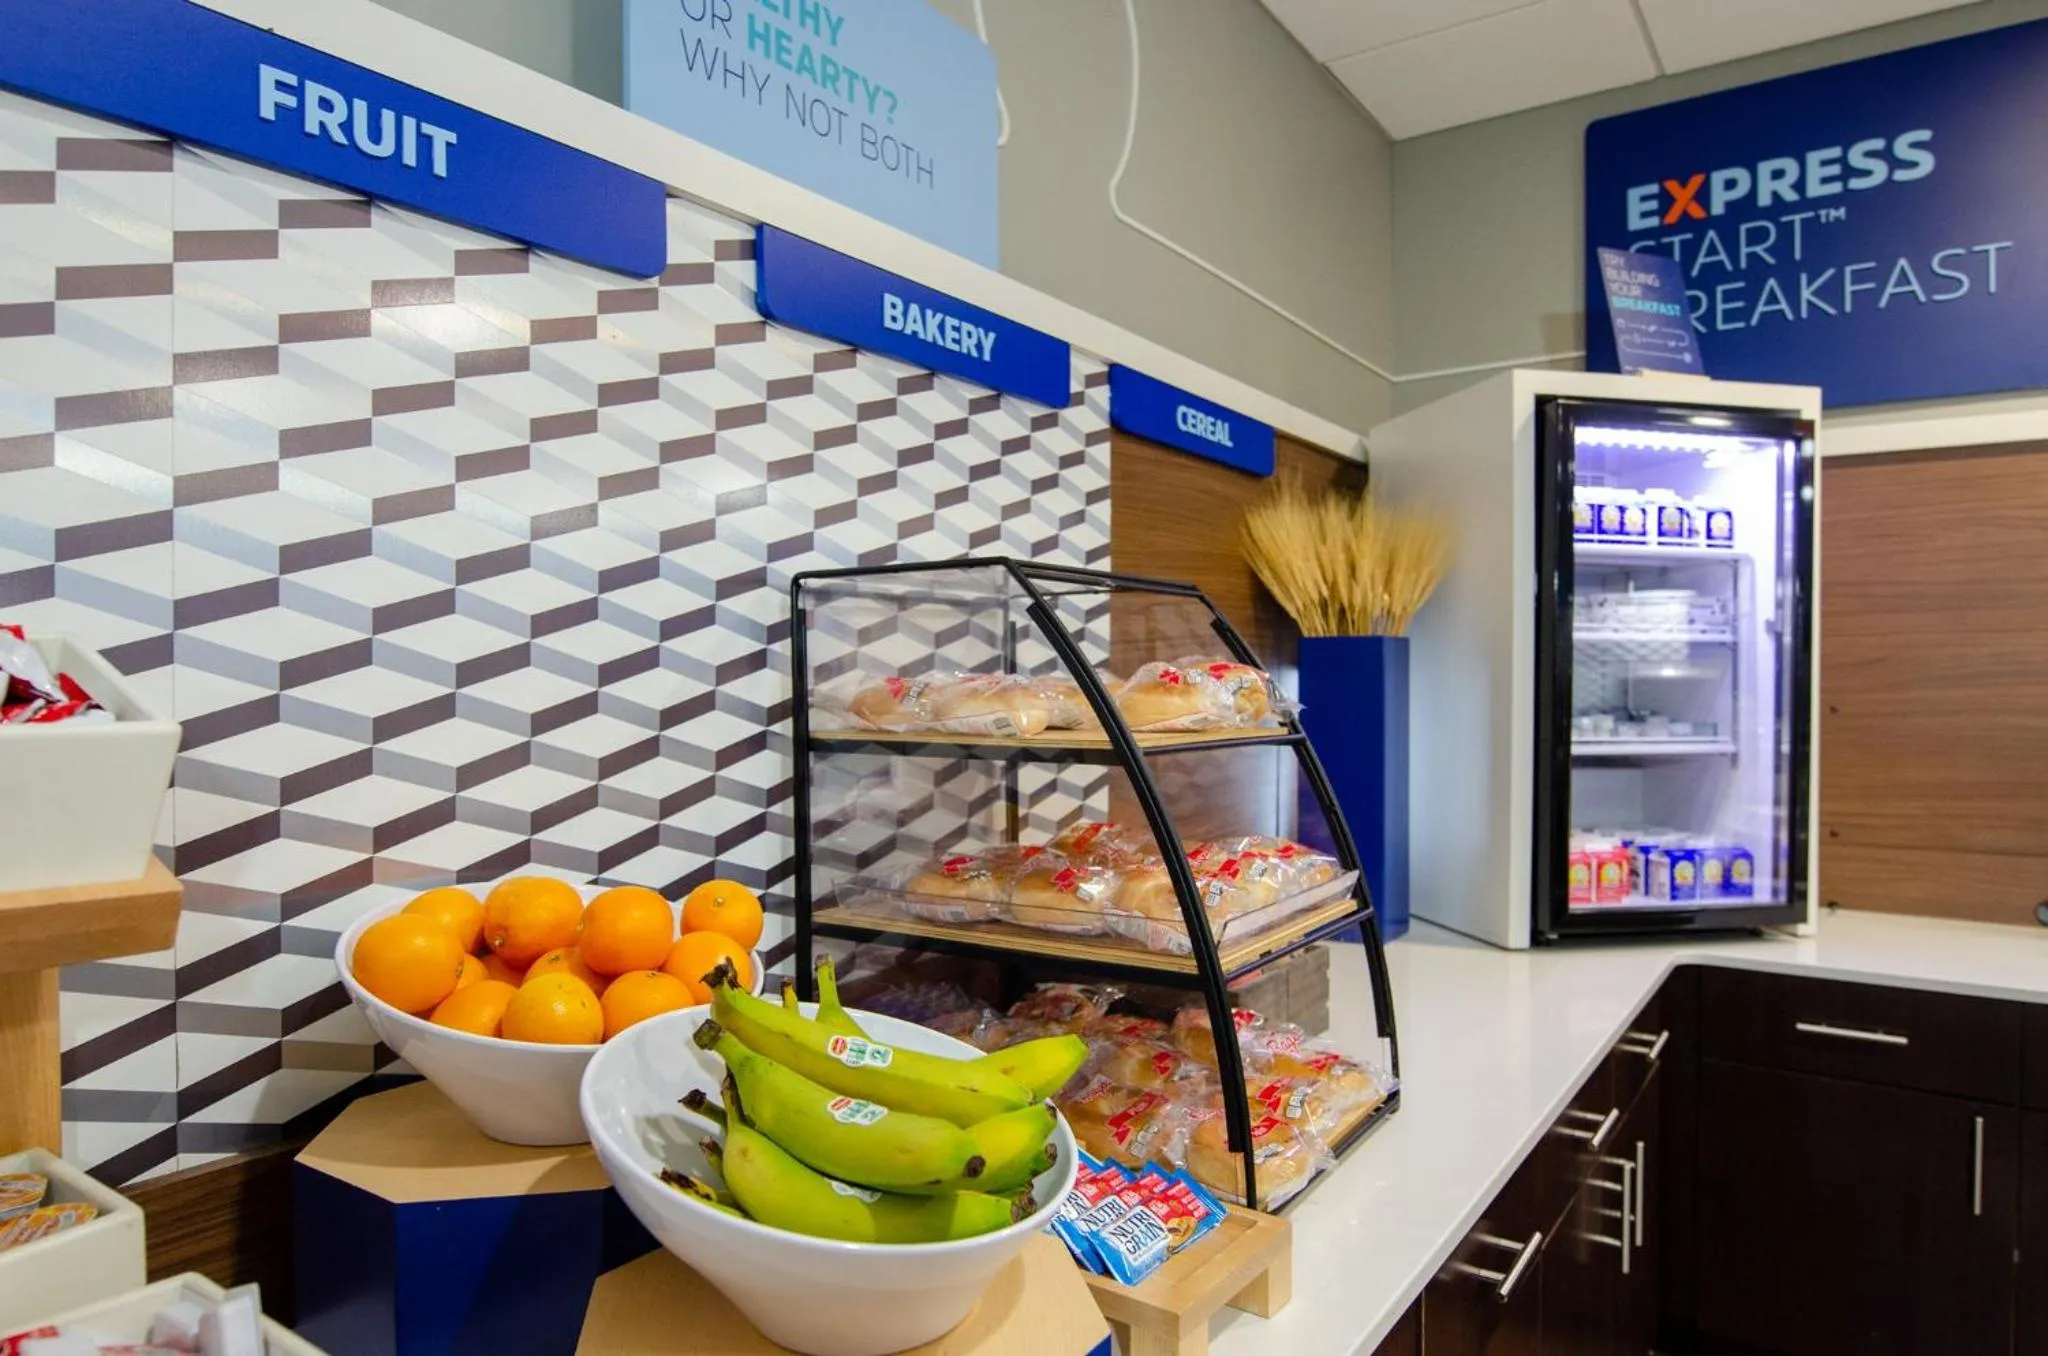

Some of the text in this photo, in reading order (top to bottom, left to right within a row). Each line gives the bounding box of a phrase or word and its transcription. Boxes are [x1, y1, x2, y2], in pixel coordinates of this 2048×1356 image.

[681, 0, 898, 125] OR HEARTY?
[258, 63, 458, 179] FRUIT
[680, 28, 934, 190] WHY NOT BOTH
[1626, 129, 1936, 232] EXPRESS
[882, 292, 997, 362] BAKERY
[1685, 241, 2014, 334] REAKFAST
[1176, 404, 1234, 448] CEREAL
[1080, 1198, 1128, 1231] NUTRI
[1106, 1209, 1150, 1243] NUTRI
[1124, 1219, 1166, 1255] GRAIN
